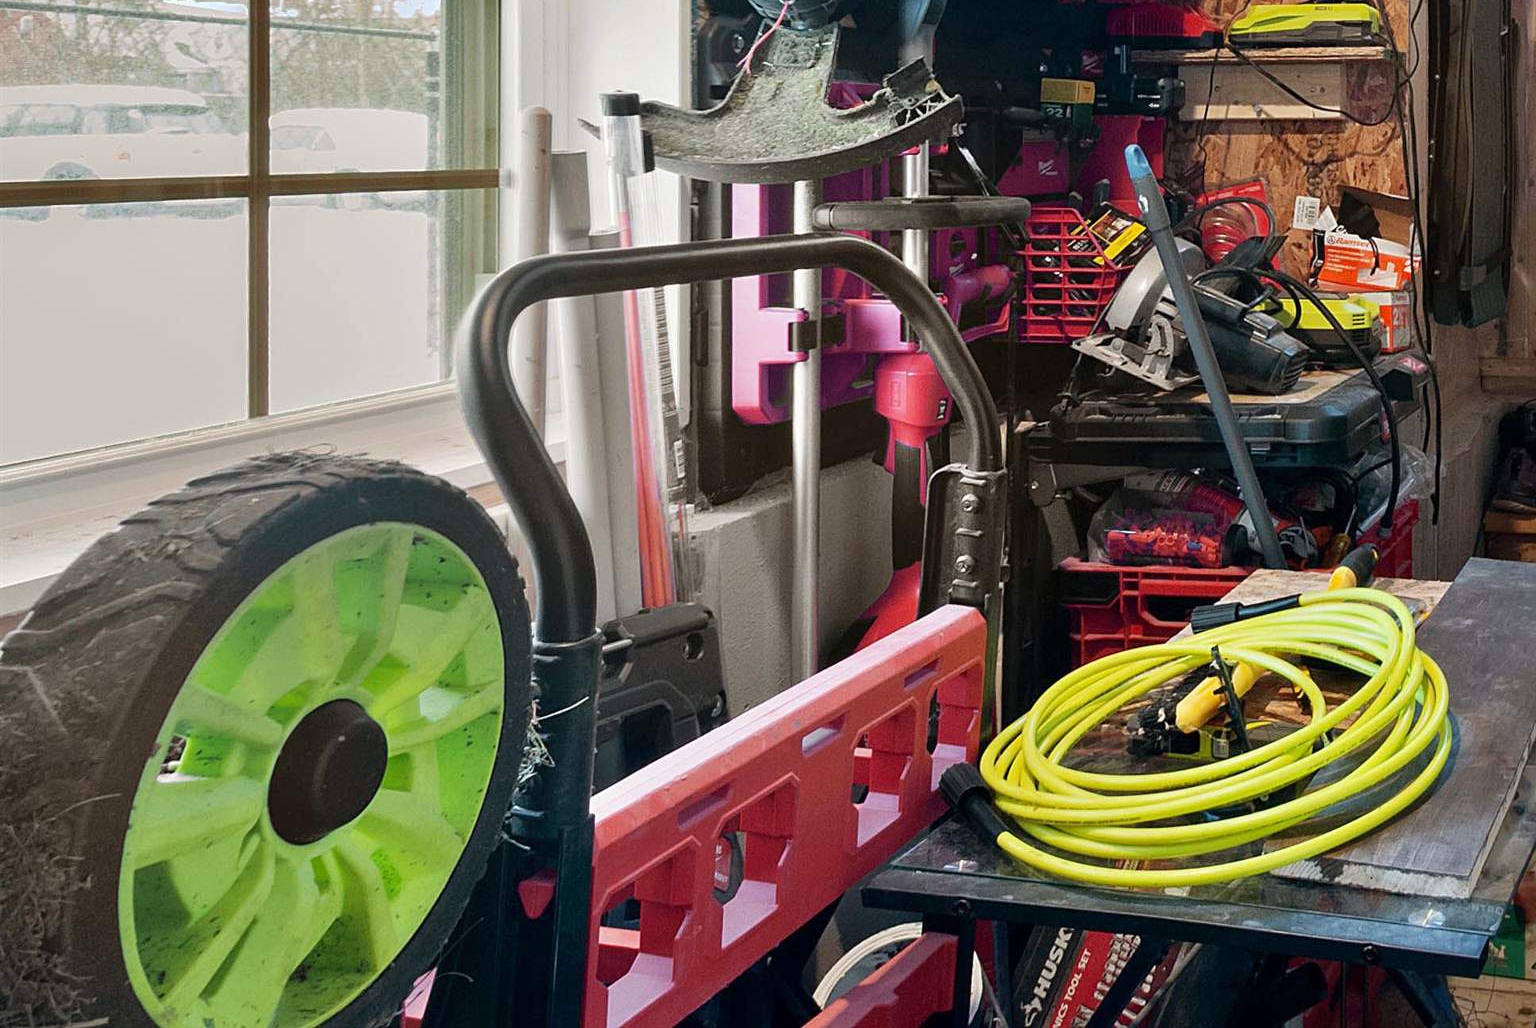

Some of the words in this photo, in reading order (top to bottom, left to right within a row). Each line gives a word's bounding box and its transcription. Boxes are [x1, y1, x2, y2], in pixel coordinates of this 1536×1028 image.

[1033, 926, 1076, 999] HUSK
[1064, 972, 1083, 1001] TOOL
[1078, 948, 1092, 970] SET
